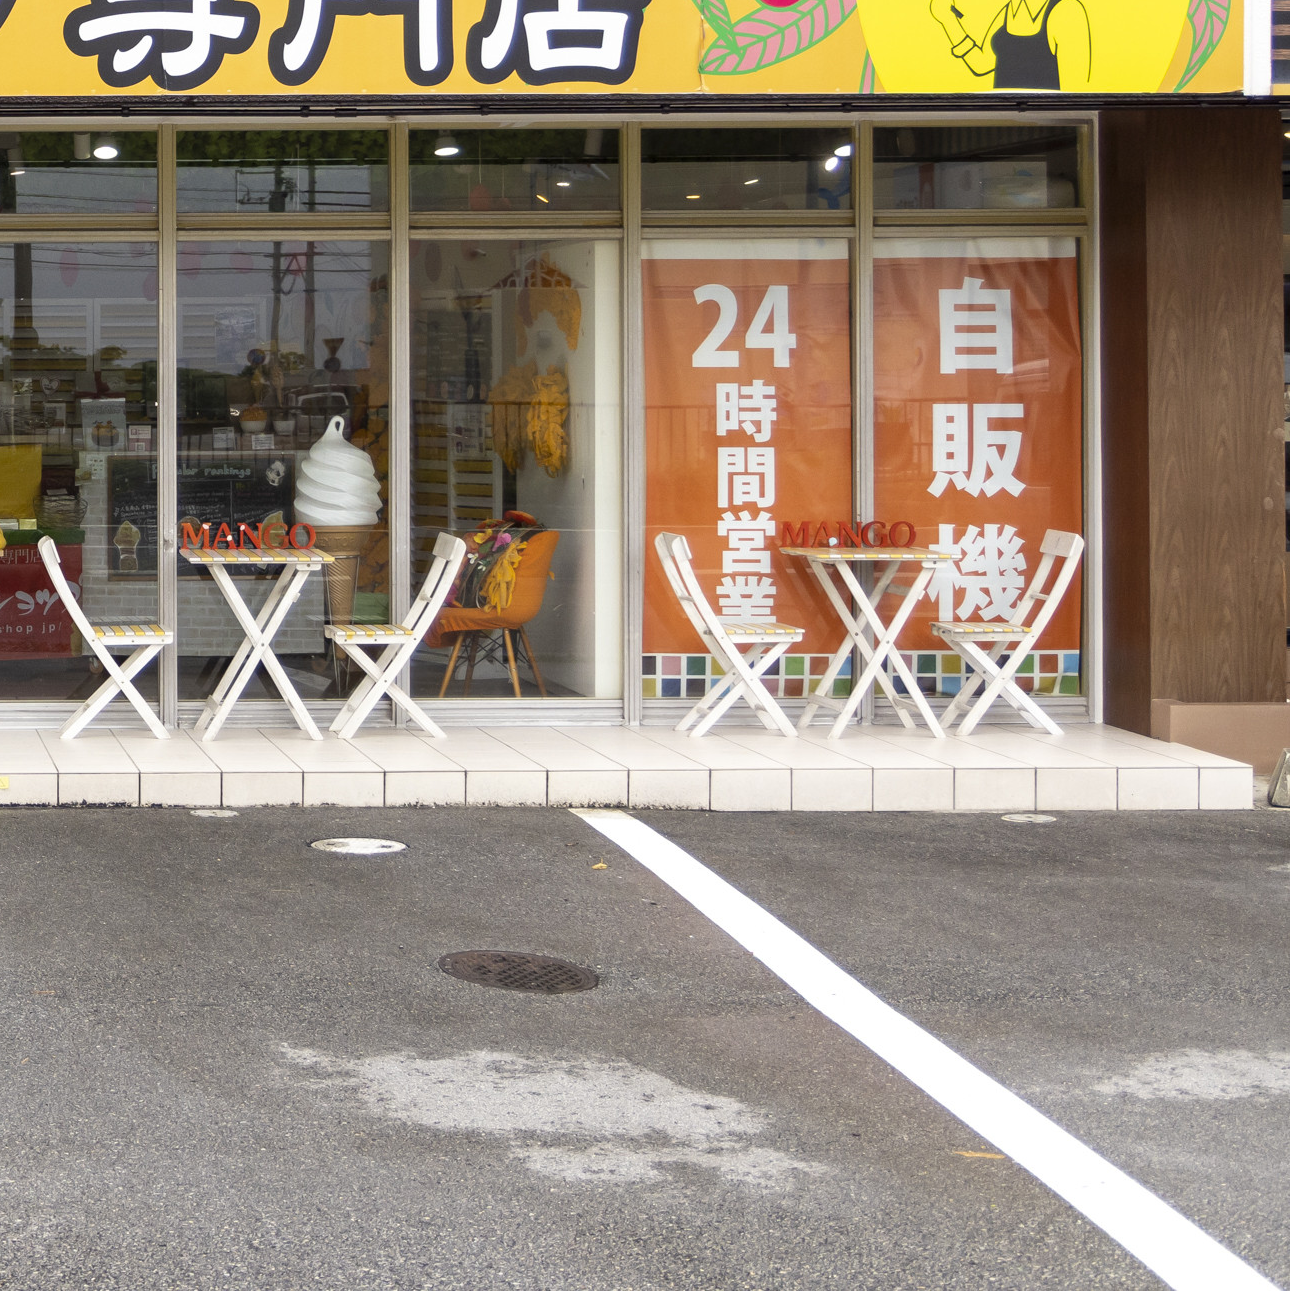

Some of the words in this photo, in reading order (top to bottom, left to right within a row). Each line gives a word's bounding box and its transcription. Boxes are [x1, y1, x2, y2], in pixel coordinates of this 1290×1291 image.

[691, 283, 796, 625] 24時間営業
[920, 277, 1026, 623] 自販機
[205, 467, 252, 478] rankings
[180, 522, 317, 550] MANGO
[780, 520, 917, 549] MANGO
